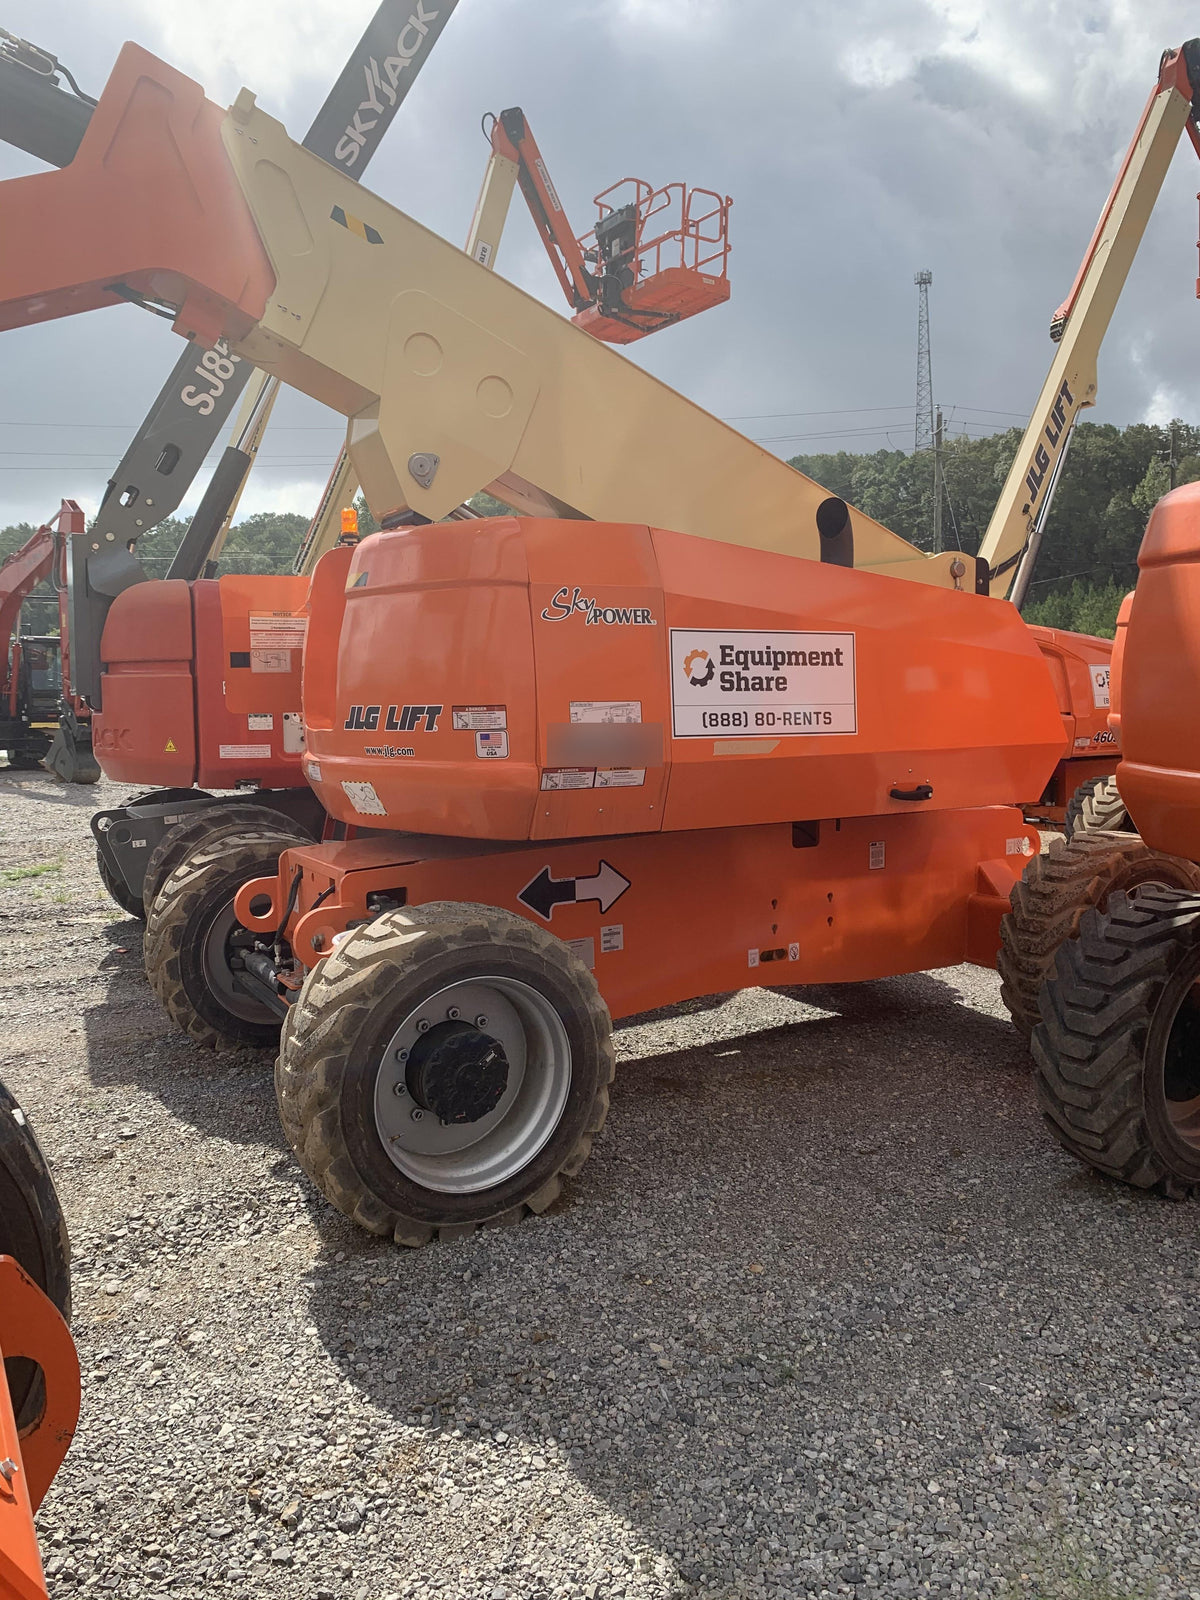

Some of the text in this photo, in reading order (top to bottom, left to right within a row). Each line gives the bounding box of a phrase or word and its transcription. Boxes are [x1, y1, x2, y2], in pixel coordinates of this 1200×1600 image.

[334, 0, 439, 168] SKYJACK
[1025, 379, 1074, 504] JLG LIFT
[719, 645, 844, 671] Equipment
[719, 671, 788, 692] Share
[344, 705, 382, 730] JLG
[384, 705, 443, 732] LIFT
[702, 711, 832, 728] (888) 80-RENTS
[1093, 731, 1117, 744] 460
[364, 745, 415, 758] www.jlg.com
